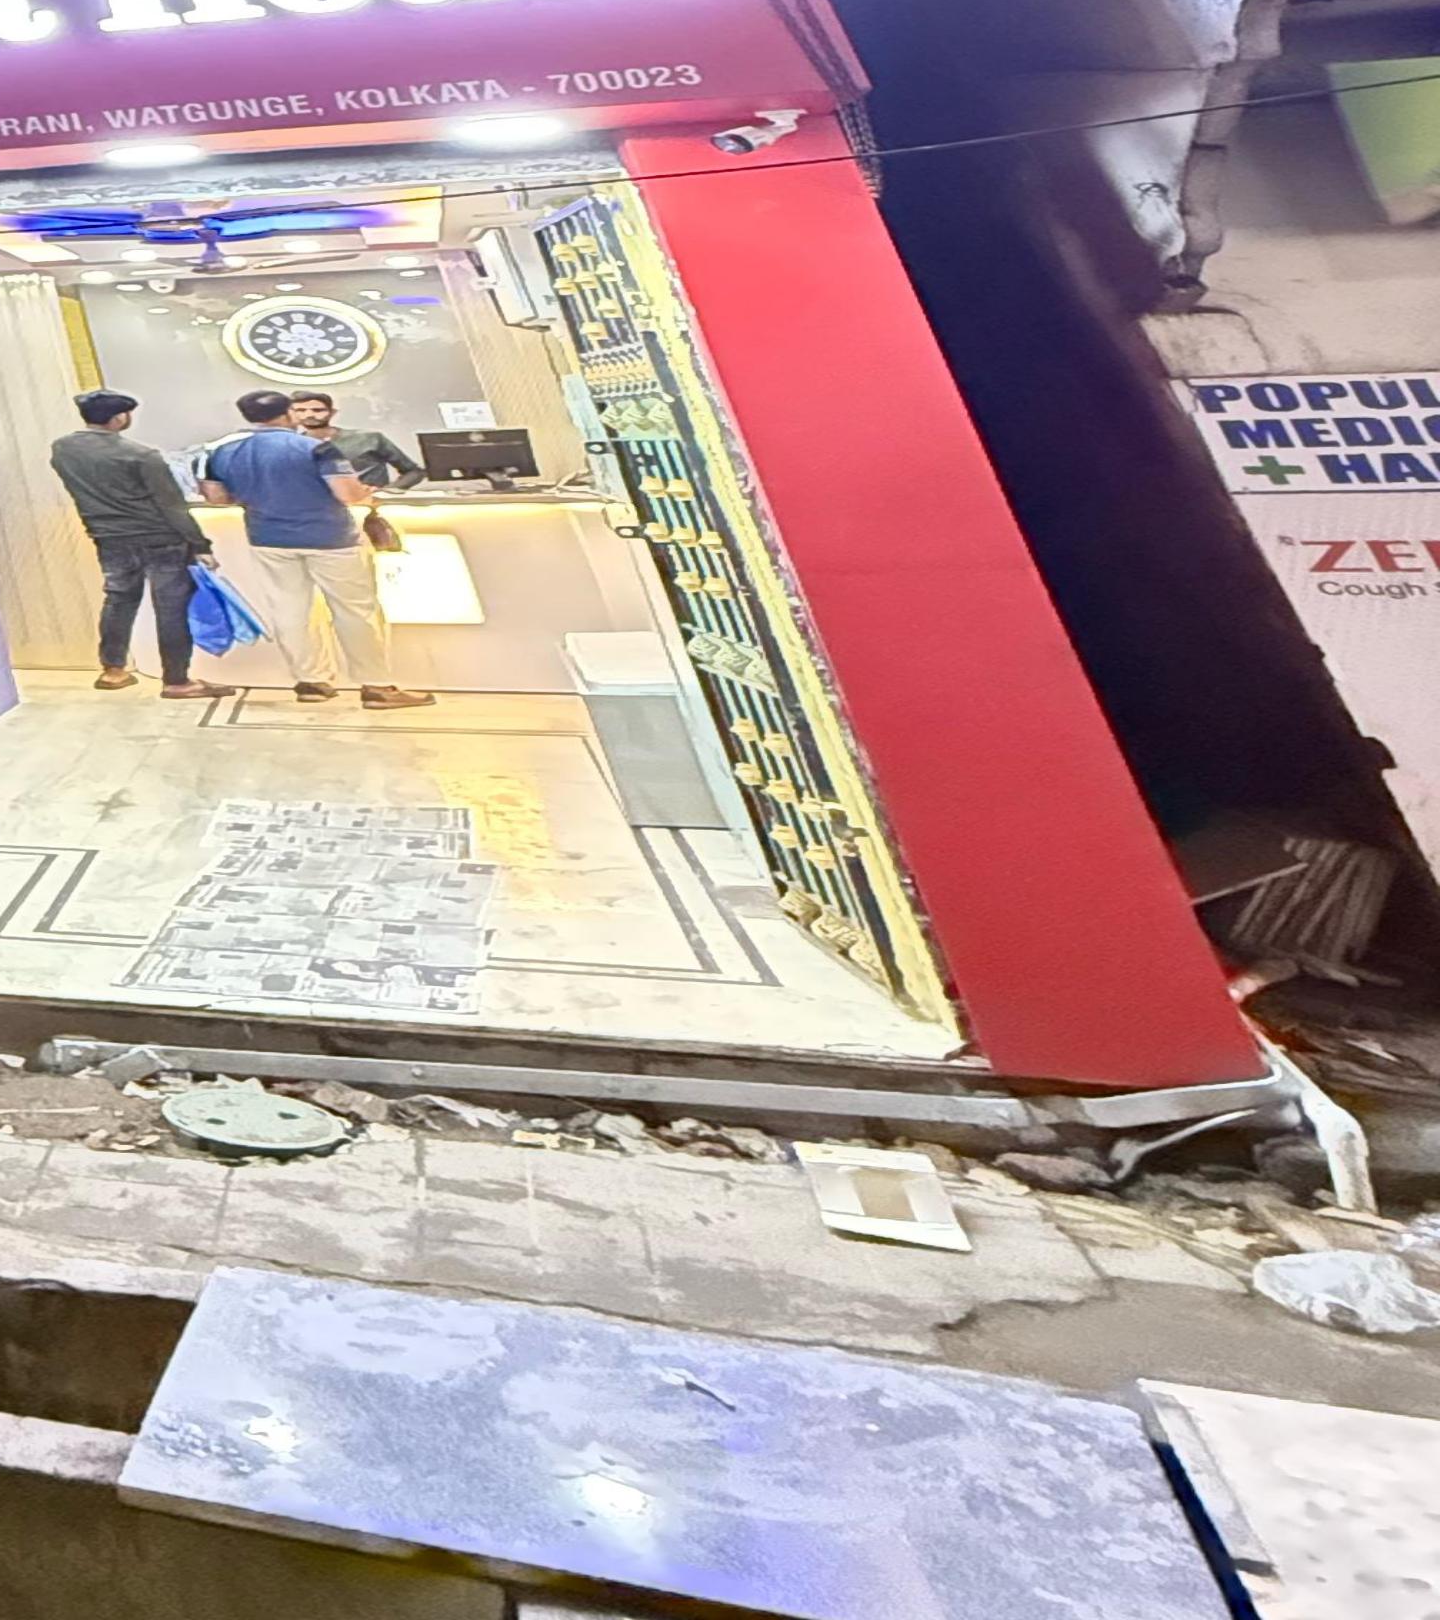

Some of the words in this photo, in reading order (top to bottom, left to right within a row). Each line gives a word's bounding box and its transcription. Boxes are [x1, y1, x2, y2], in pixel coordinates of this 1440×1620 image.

[104, 94, 325, 130] WATGUNGE,
[336, 80, 509, 111] KOLKATA
[547, 64, 704, 95] 700023
[1316, 453, 1440, 484] HA
[1317, 580, 1428, 599] Cough
